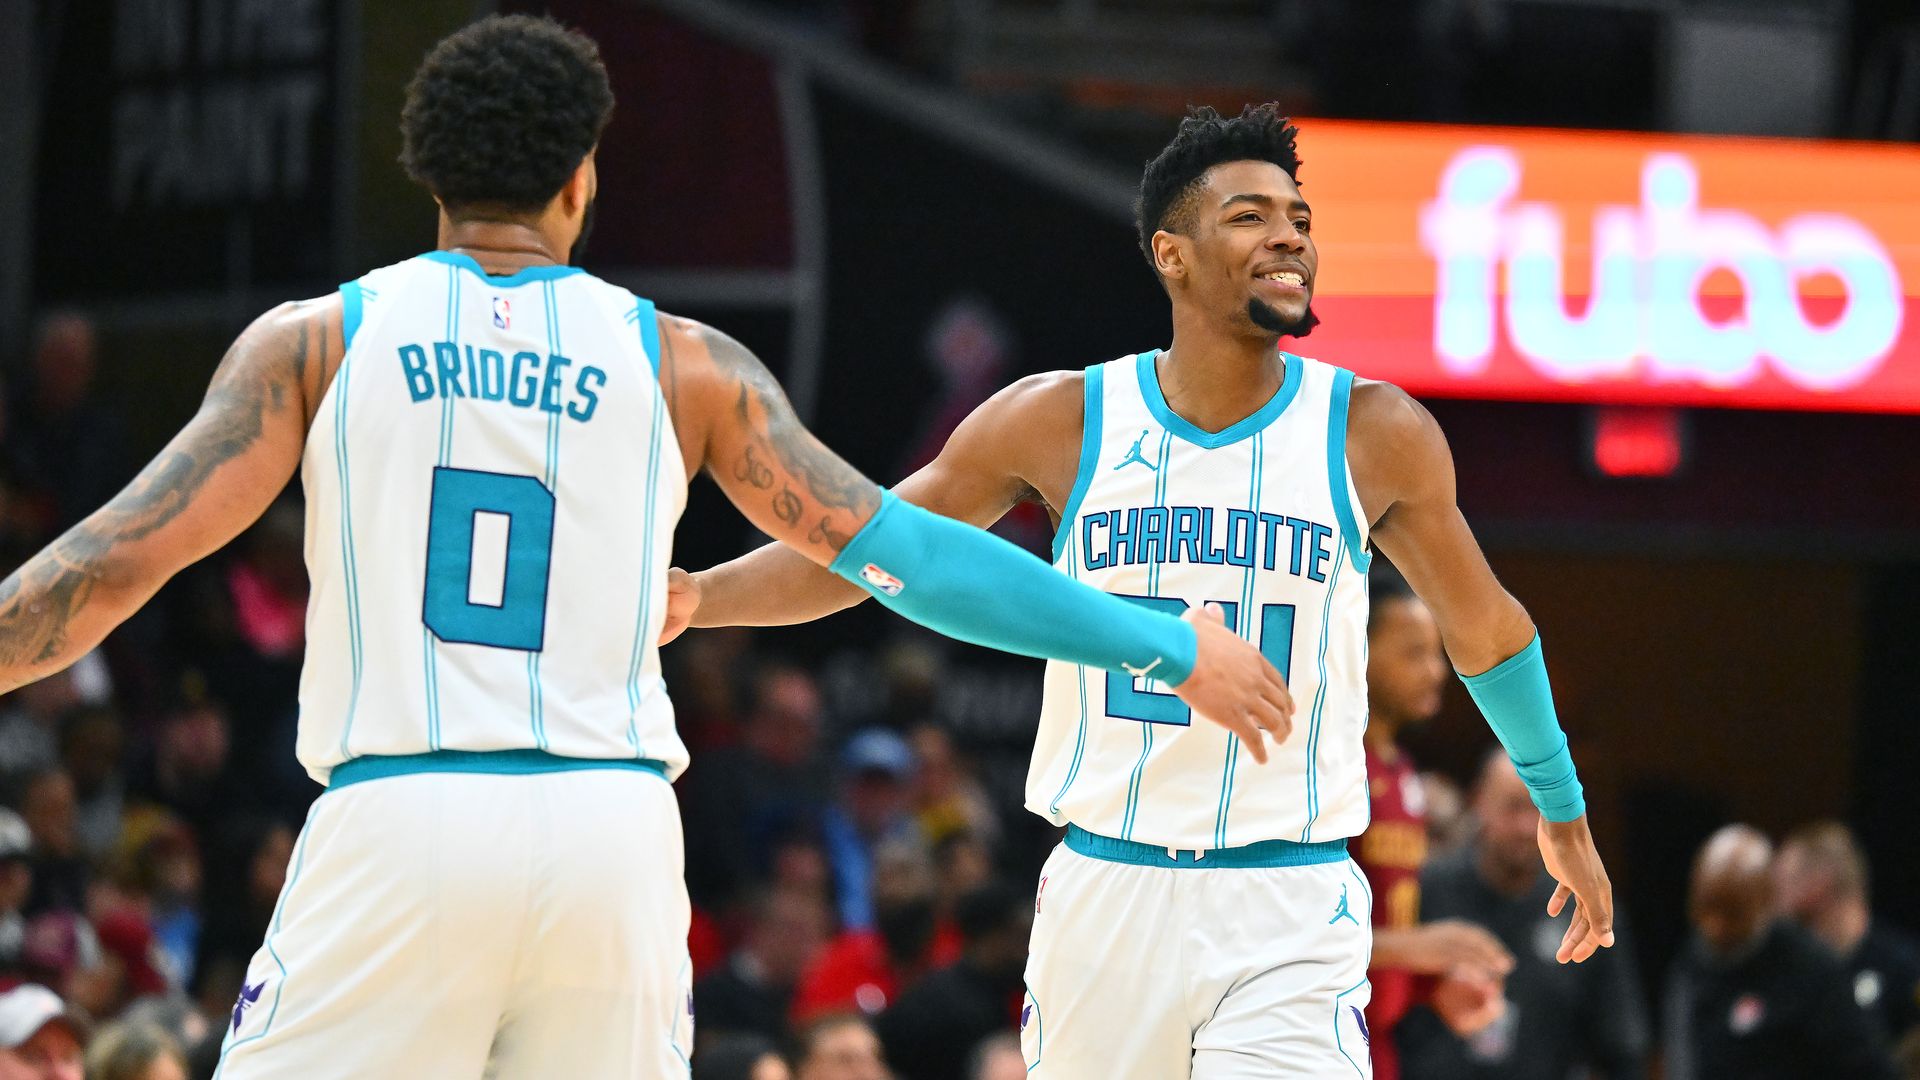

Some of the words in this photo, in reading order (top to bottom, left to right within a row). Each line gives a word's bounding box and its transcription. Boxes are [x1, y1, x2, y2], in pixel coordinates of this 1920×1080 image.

[1420, 145, 1904, 392] fubo
[398, 341, 606, 422] BRIDGES
[422, 465, 556, 653] 0
[1082, 506, 1333, 583] CHARLOTTE
